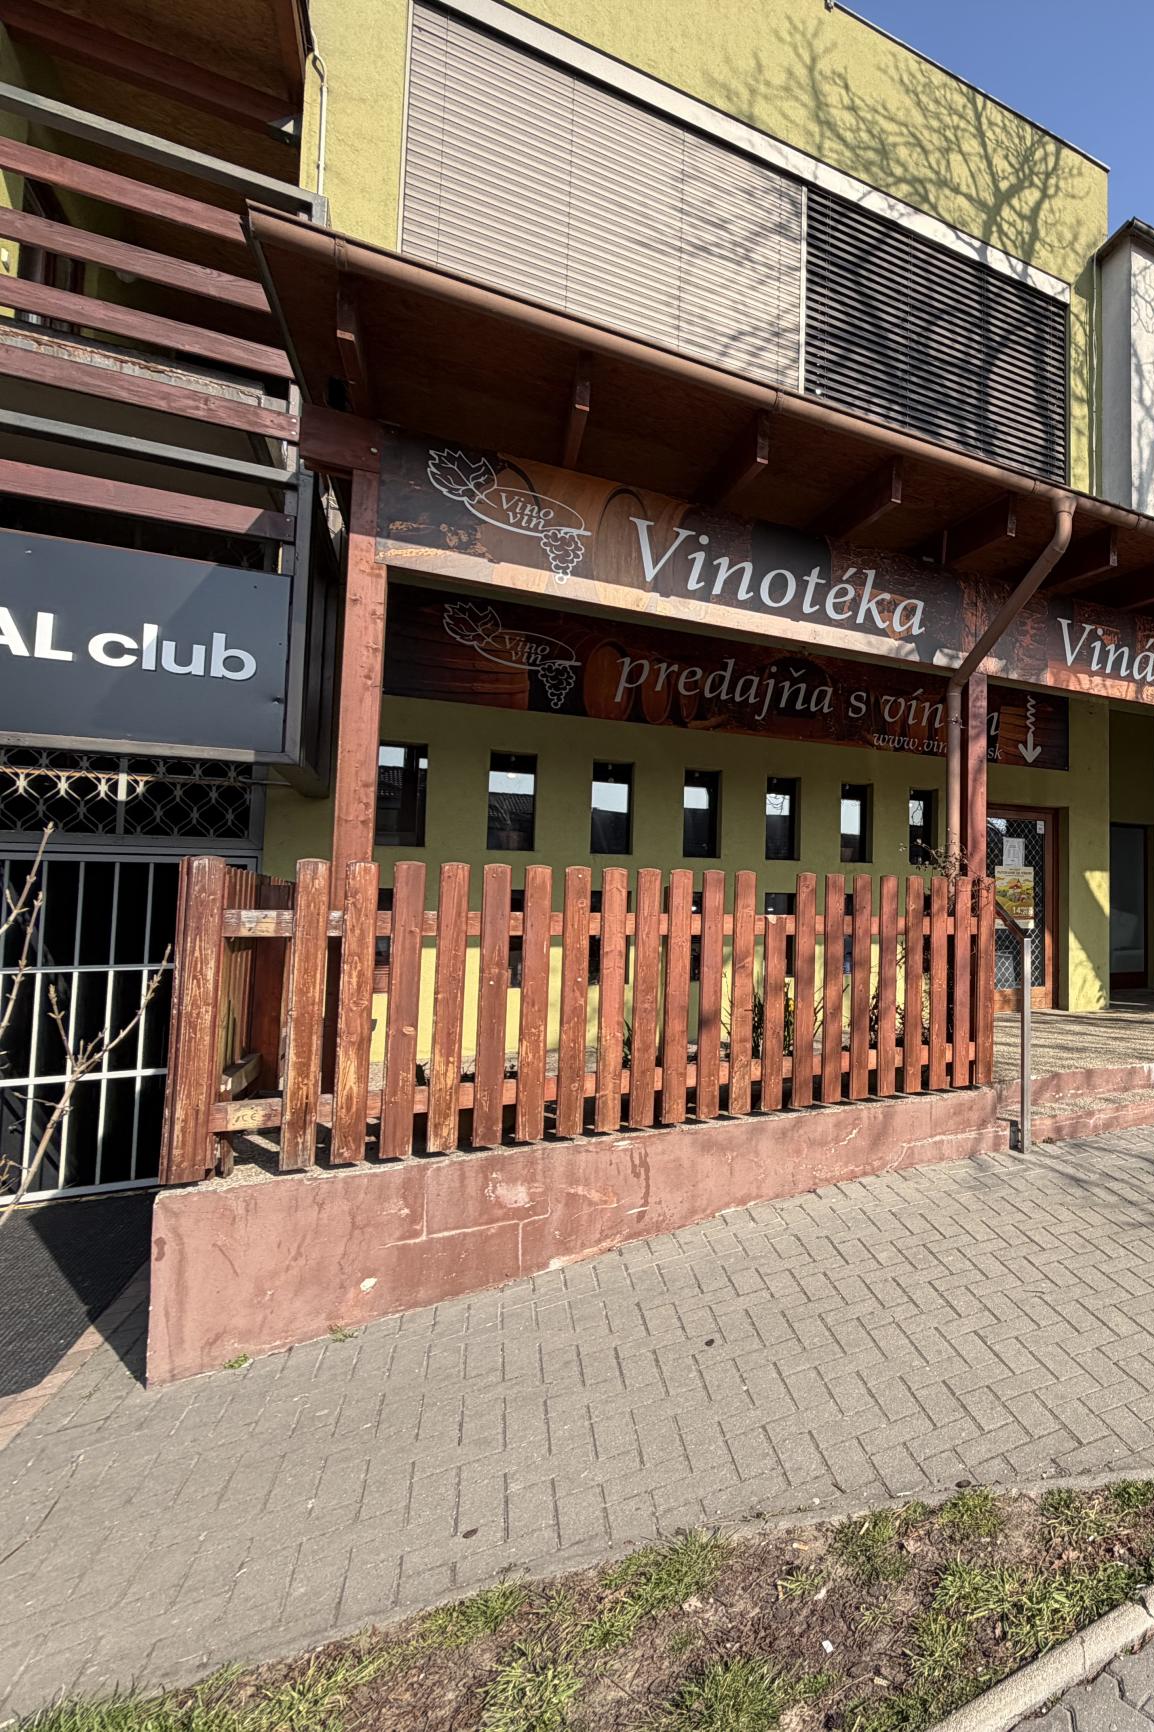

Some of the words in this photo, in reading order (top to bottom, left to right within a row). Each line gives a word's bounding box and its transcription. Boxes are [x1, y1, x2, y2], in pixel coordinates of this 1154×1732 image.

[500, 492, 554, 519] Vino
[507, 511, 545, 530] vin
[629, 515, 926, 636] Vinotéka
[88, 622, 257, 681] club
[503, 635, 550, 655] Vino
[614, 655, 834, 721] predajňa
[848, 690, 868, 717] s
